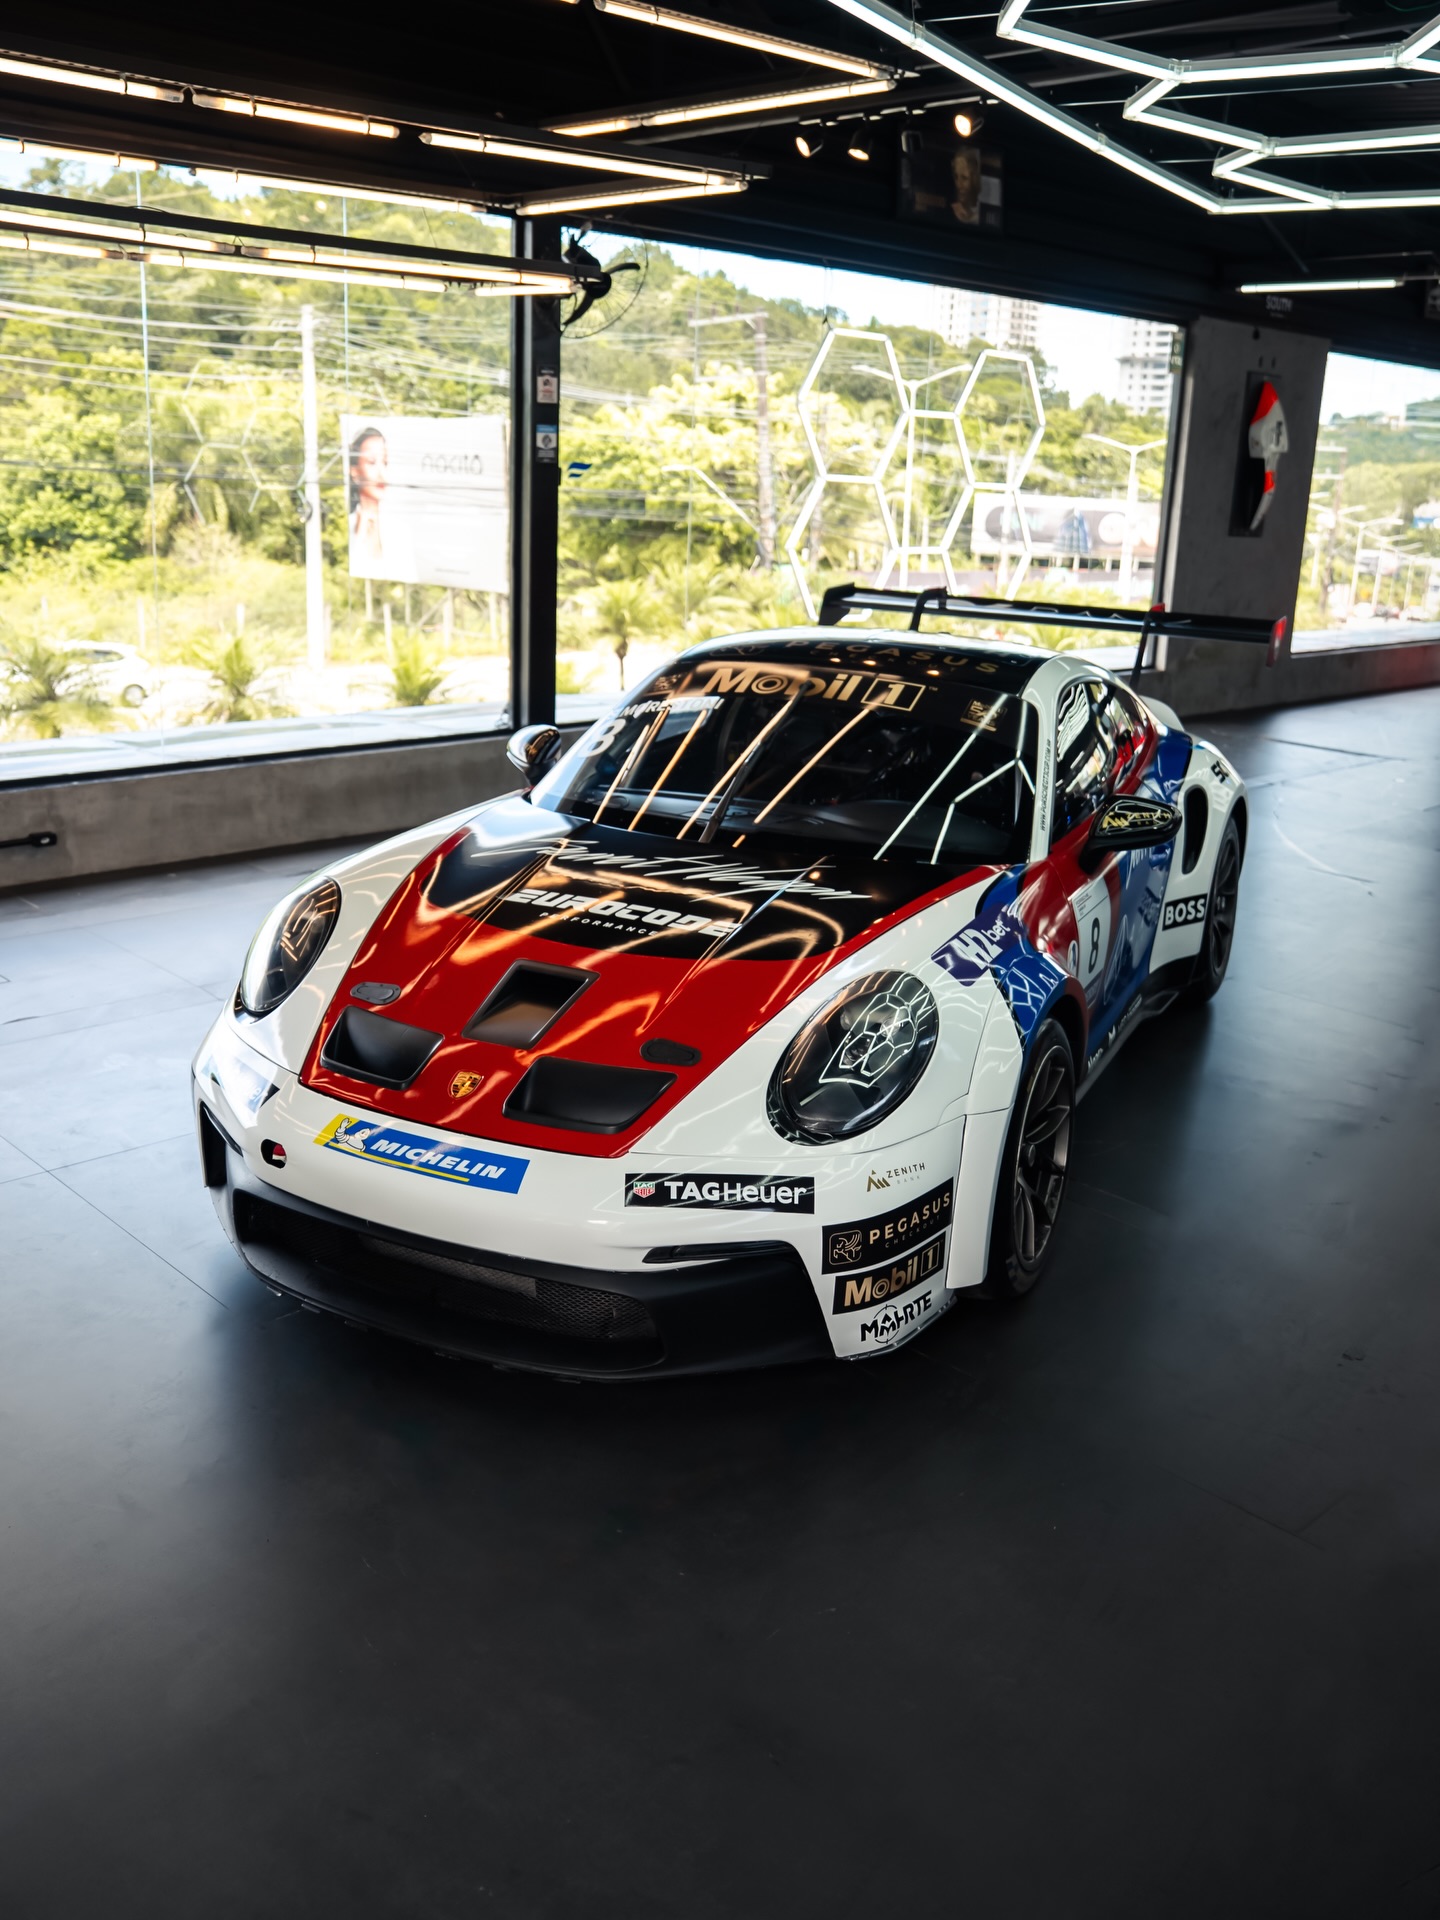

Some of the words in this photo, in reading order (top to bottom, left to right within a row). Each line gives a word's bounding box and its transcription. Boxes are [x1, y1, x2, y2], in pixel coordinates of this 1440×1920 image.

[785, 640, 1000, 673] PEGASUS
[704, 667, 863, 701] Mobil
[577, 718, 626, 757] 8
[539, 911, 658, 937] PERFORMANCE
[1164, 898, 1205, 927] BOSS
[1088, 917, 1100, 974] 8
[370, 1139, 506, 1180] MICHELIN
[886, 1162, 926, 1179] ZENITH
[869, 1192, 950, 1245] PEGASUS
[844, 1255, 918, 1307] Mobil
